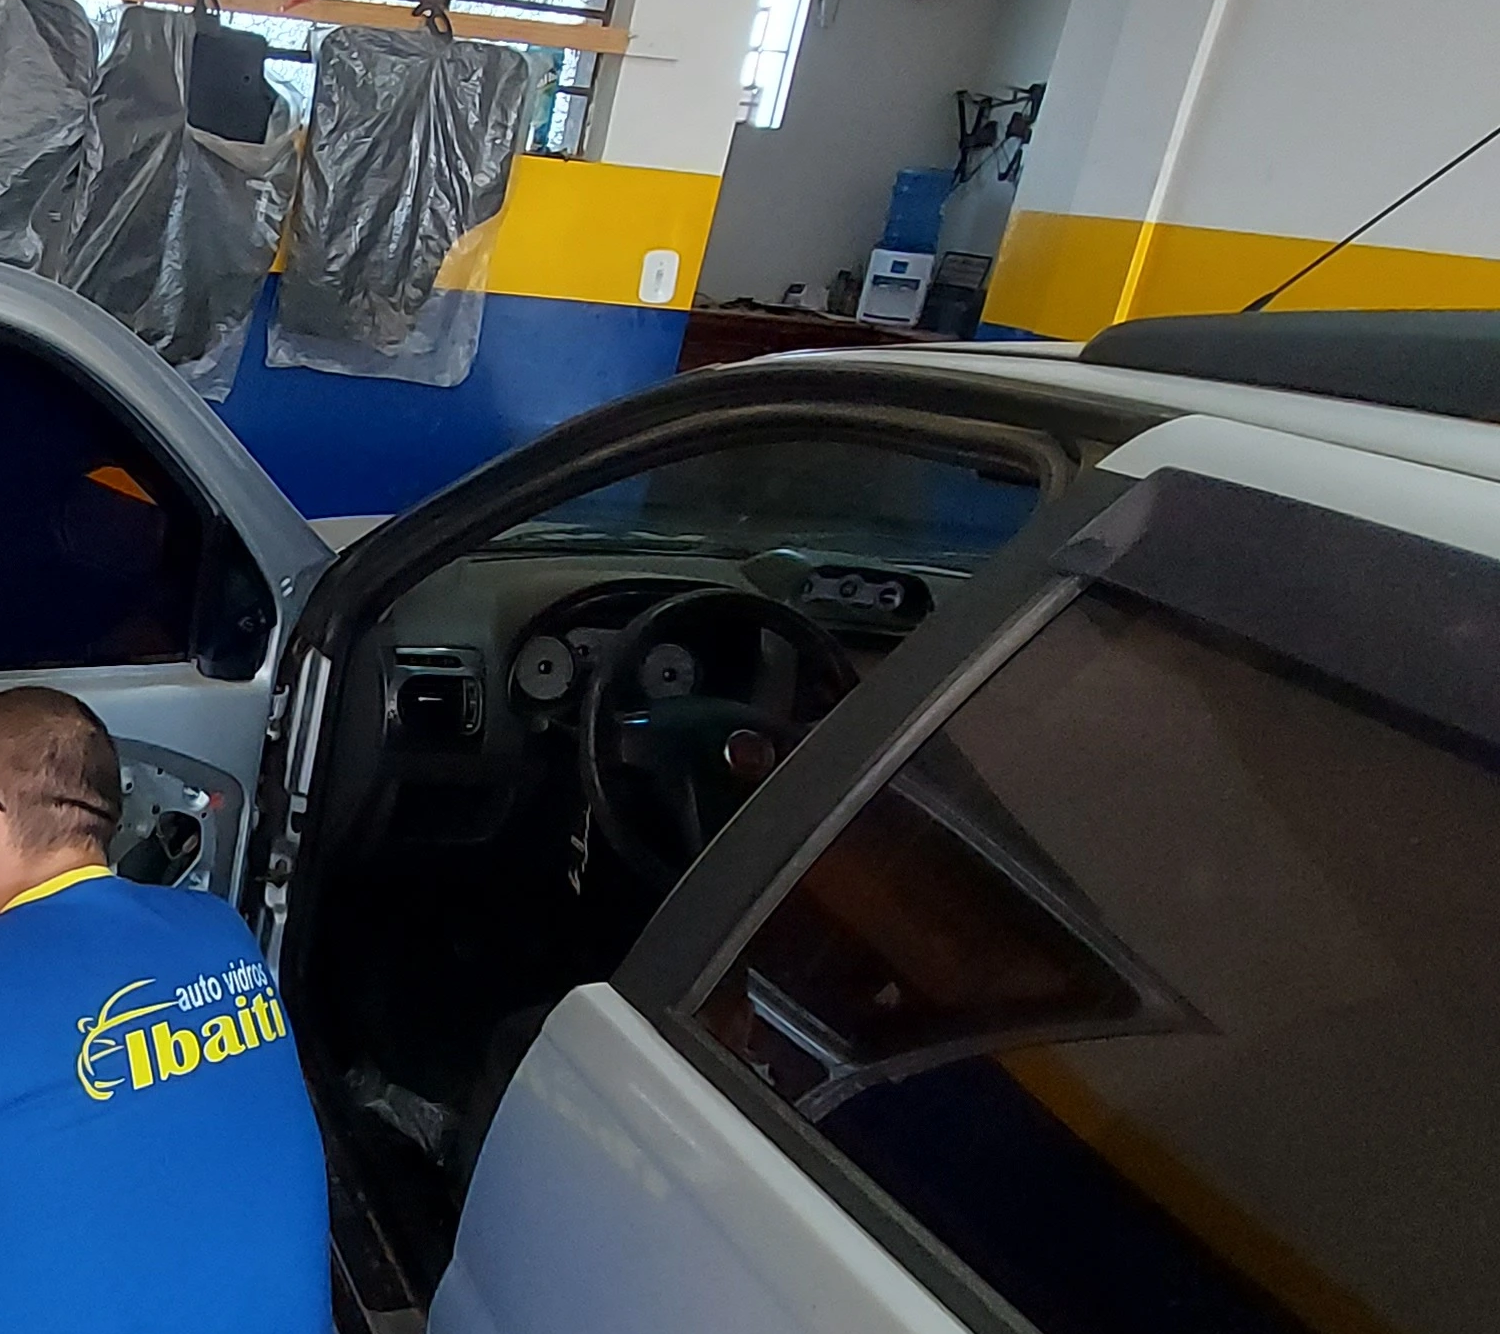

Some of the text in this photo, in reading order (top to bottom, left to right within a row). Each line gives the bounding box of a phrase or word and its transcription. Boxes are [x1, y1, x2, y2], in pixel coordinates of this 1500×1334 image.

[175, 959, 268, 1012] auto vidros
[125, 986, 287, 1090] Ibaiti
